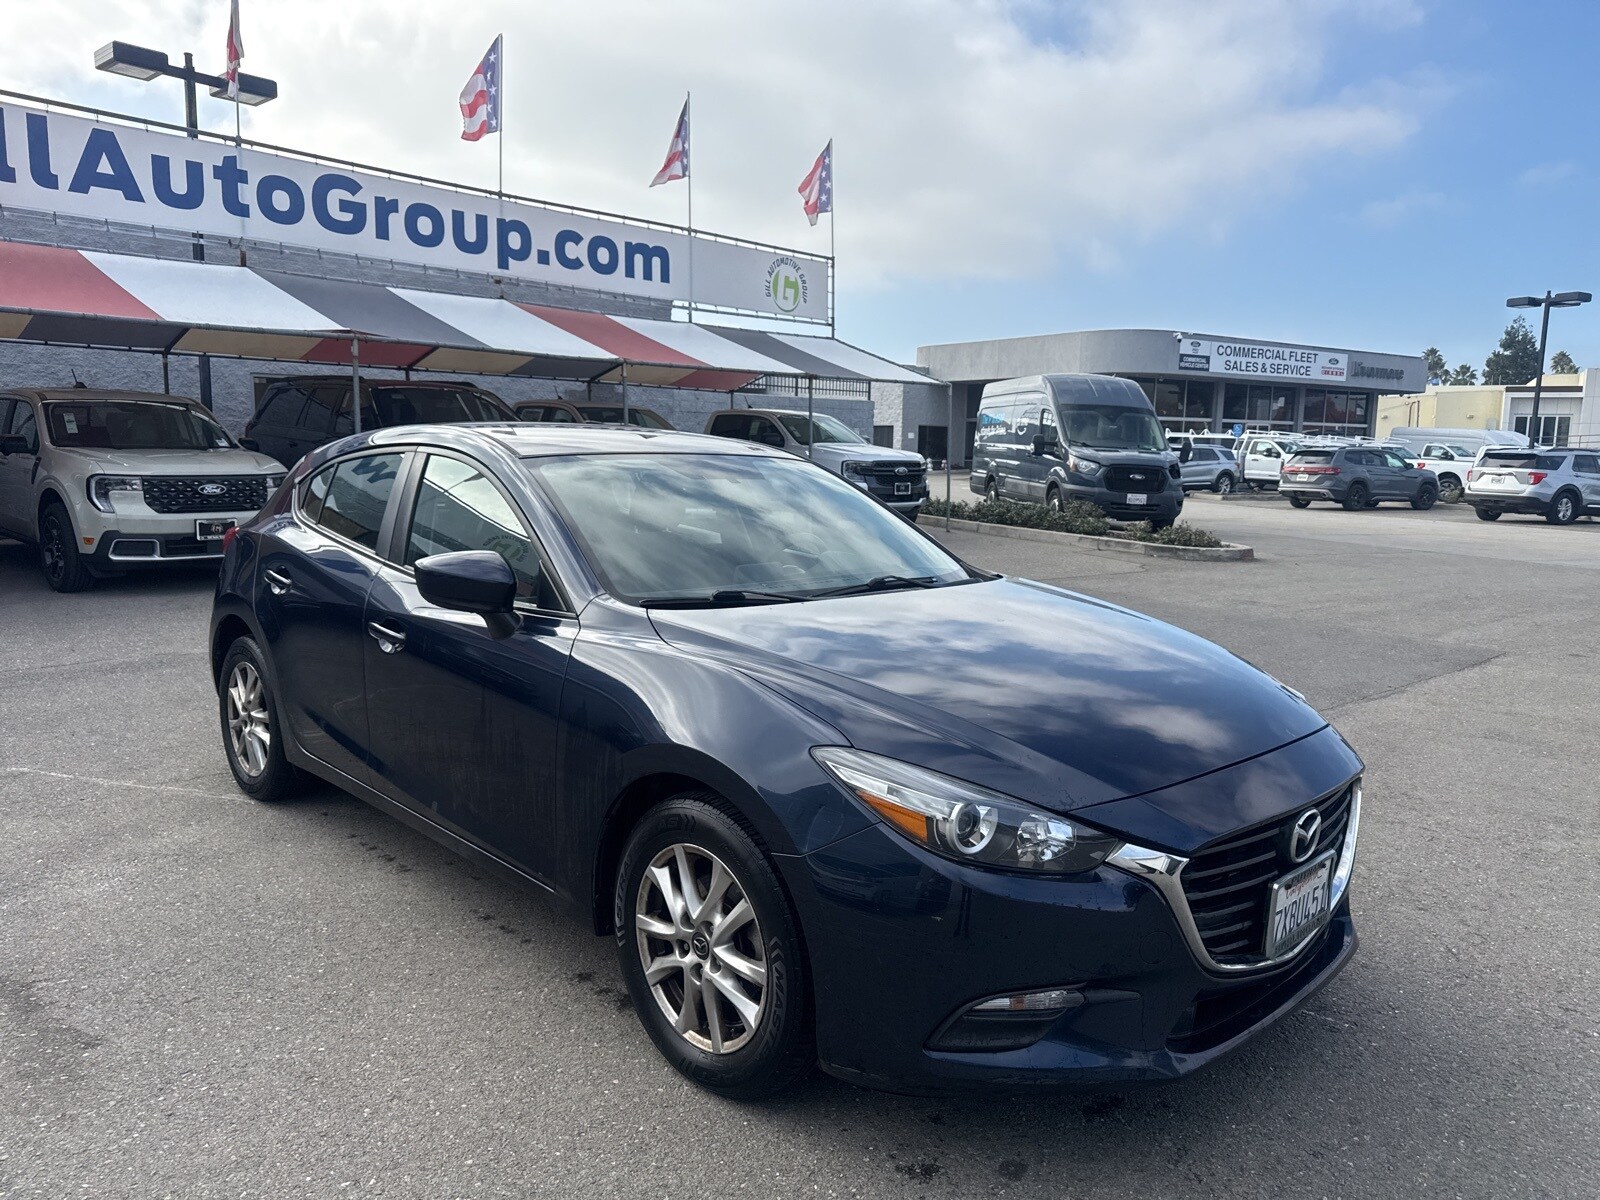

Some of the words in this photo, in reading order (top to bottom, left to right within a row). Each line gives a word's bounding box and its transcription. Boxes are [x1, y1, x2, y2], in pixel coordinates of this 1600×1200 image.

[767, 257, 801, 278] AUTOMOTIVE
[764, 279, 772, 298] GILL
[799, 273, 808, 304] GROUP
[1217, 345, 1287, 361] COMMERCIAL
[1289, 351, 1318, 364] FLEET
[1224, 360, 1259, 372] SALES
[1260, 362, 1267, 373] &
[1269, 363, 1311, 376] SERVICE
[1273, 881, 1328, 943] 7XBU451
